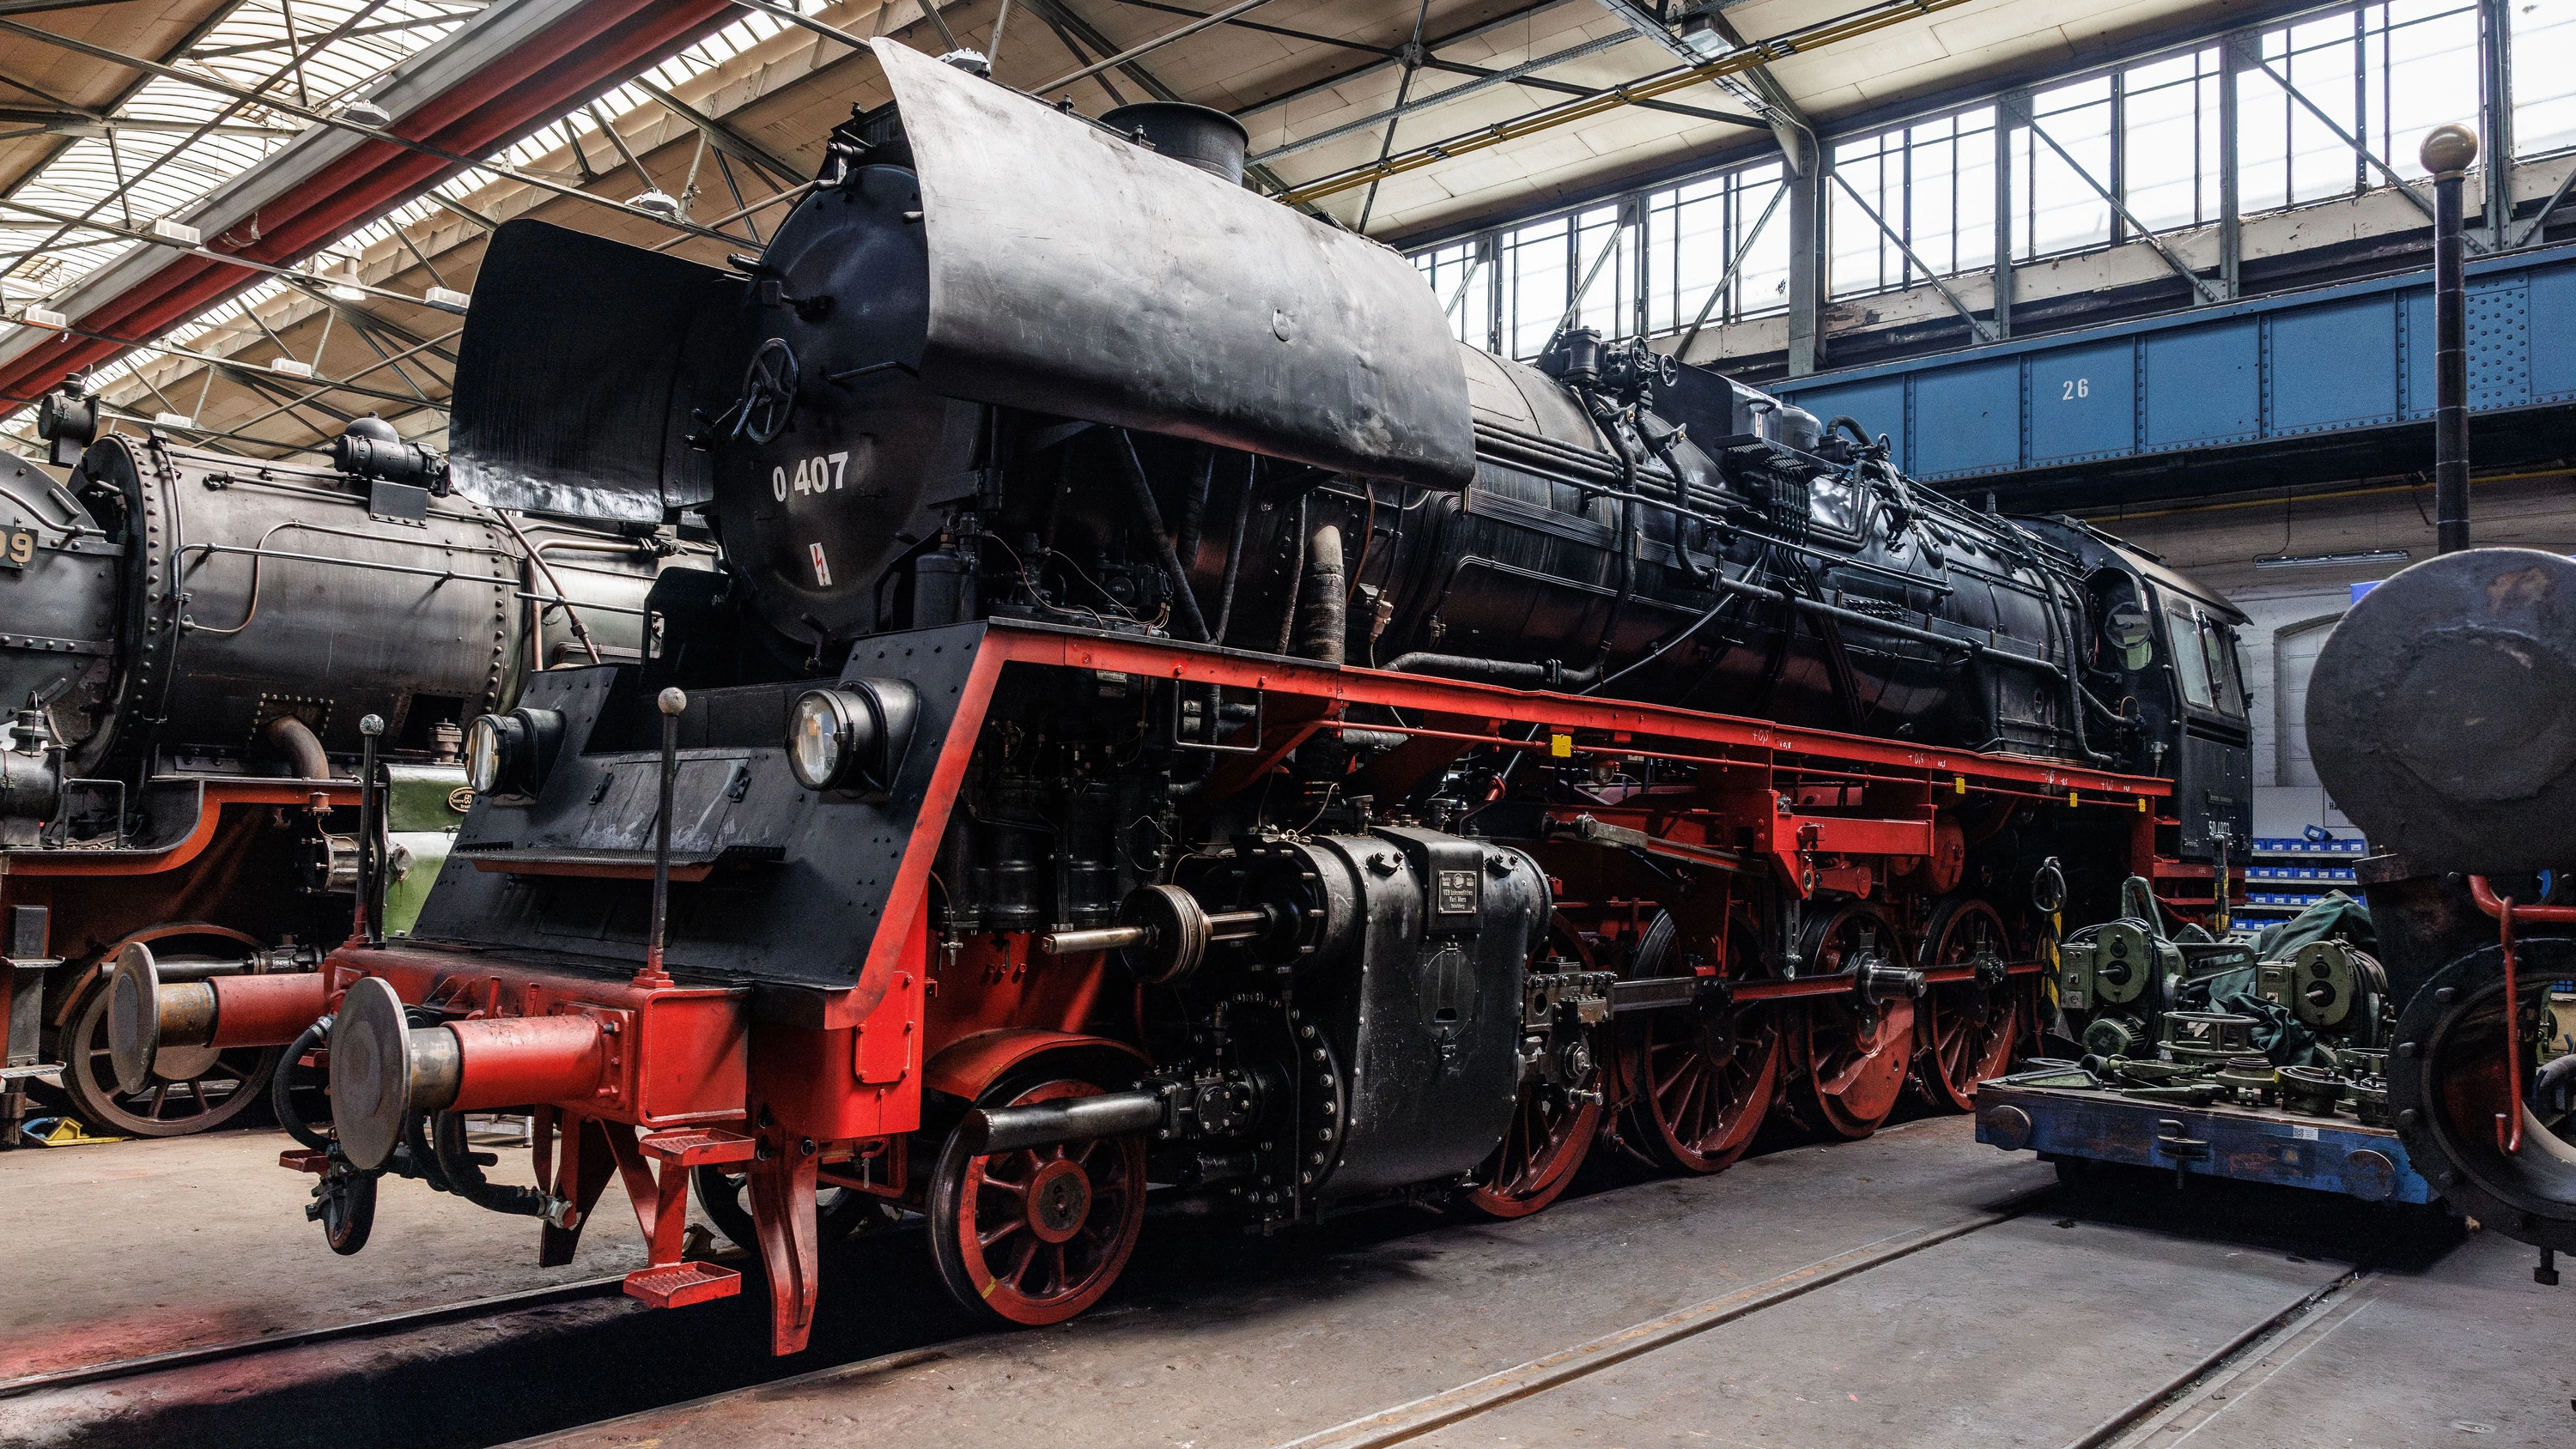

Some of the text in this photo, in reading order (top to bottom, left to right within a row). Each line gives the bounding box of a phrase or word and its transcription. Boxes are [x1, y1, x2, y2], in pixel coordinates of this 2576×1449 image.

[2063, 379, 2088, 400] 26
[773, 452, 848, 502] 0 407
[0, 529, 33, 563] 9
